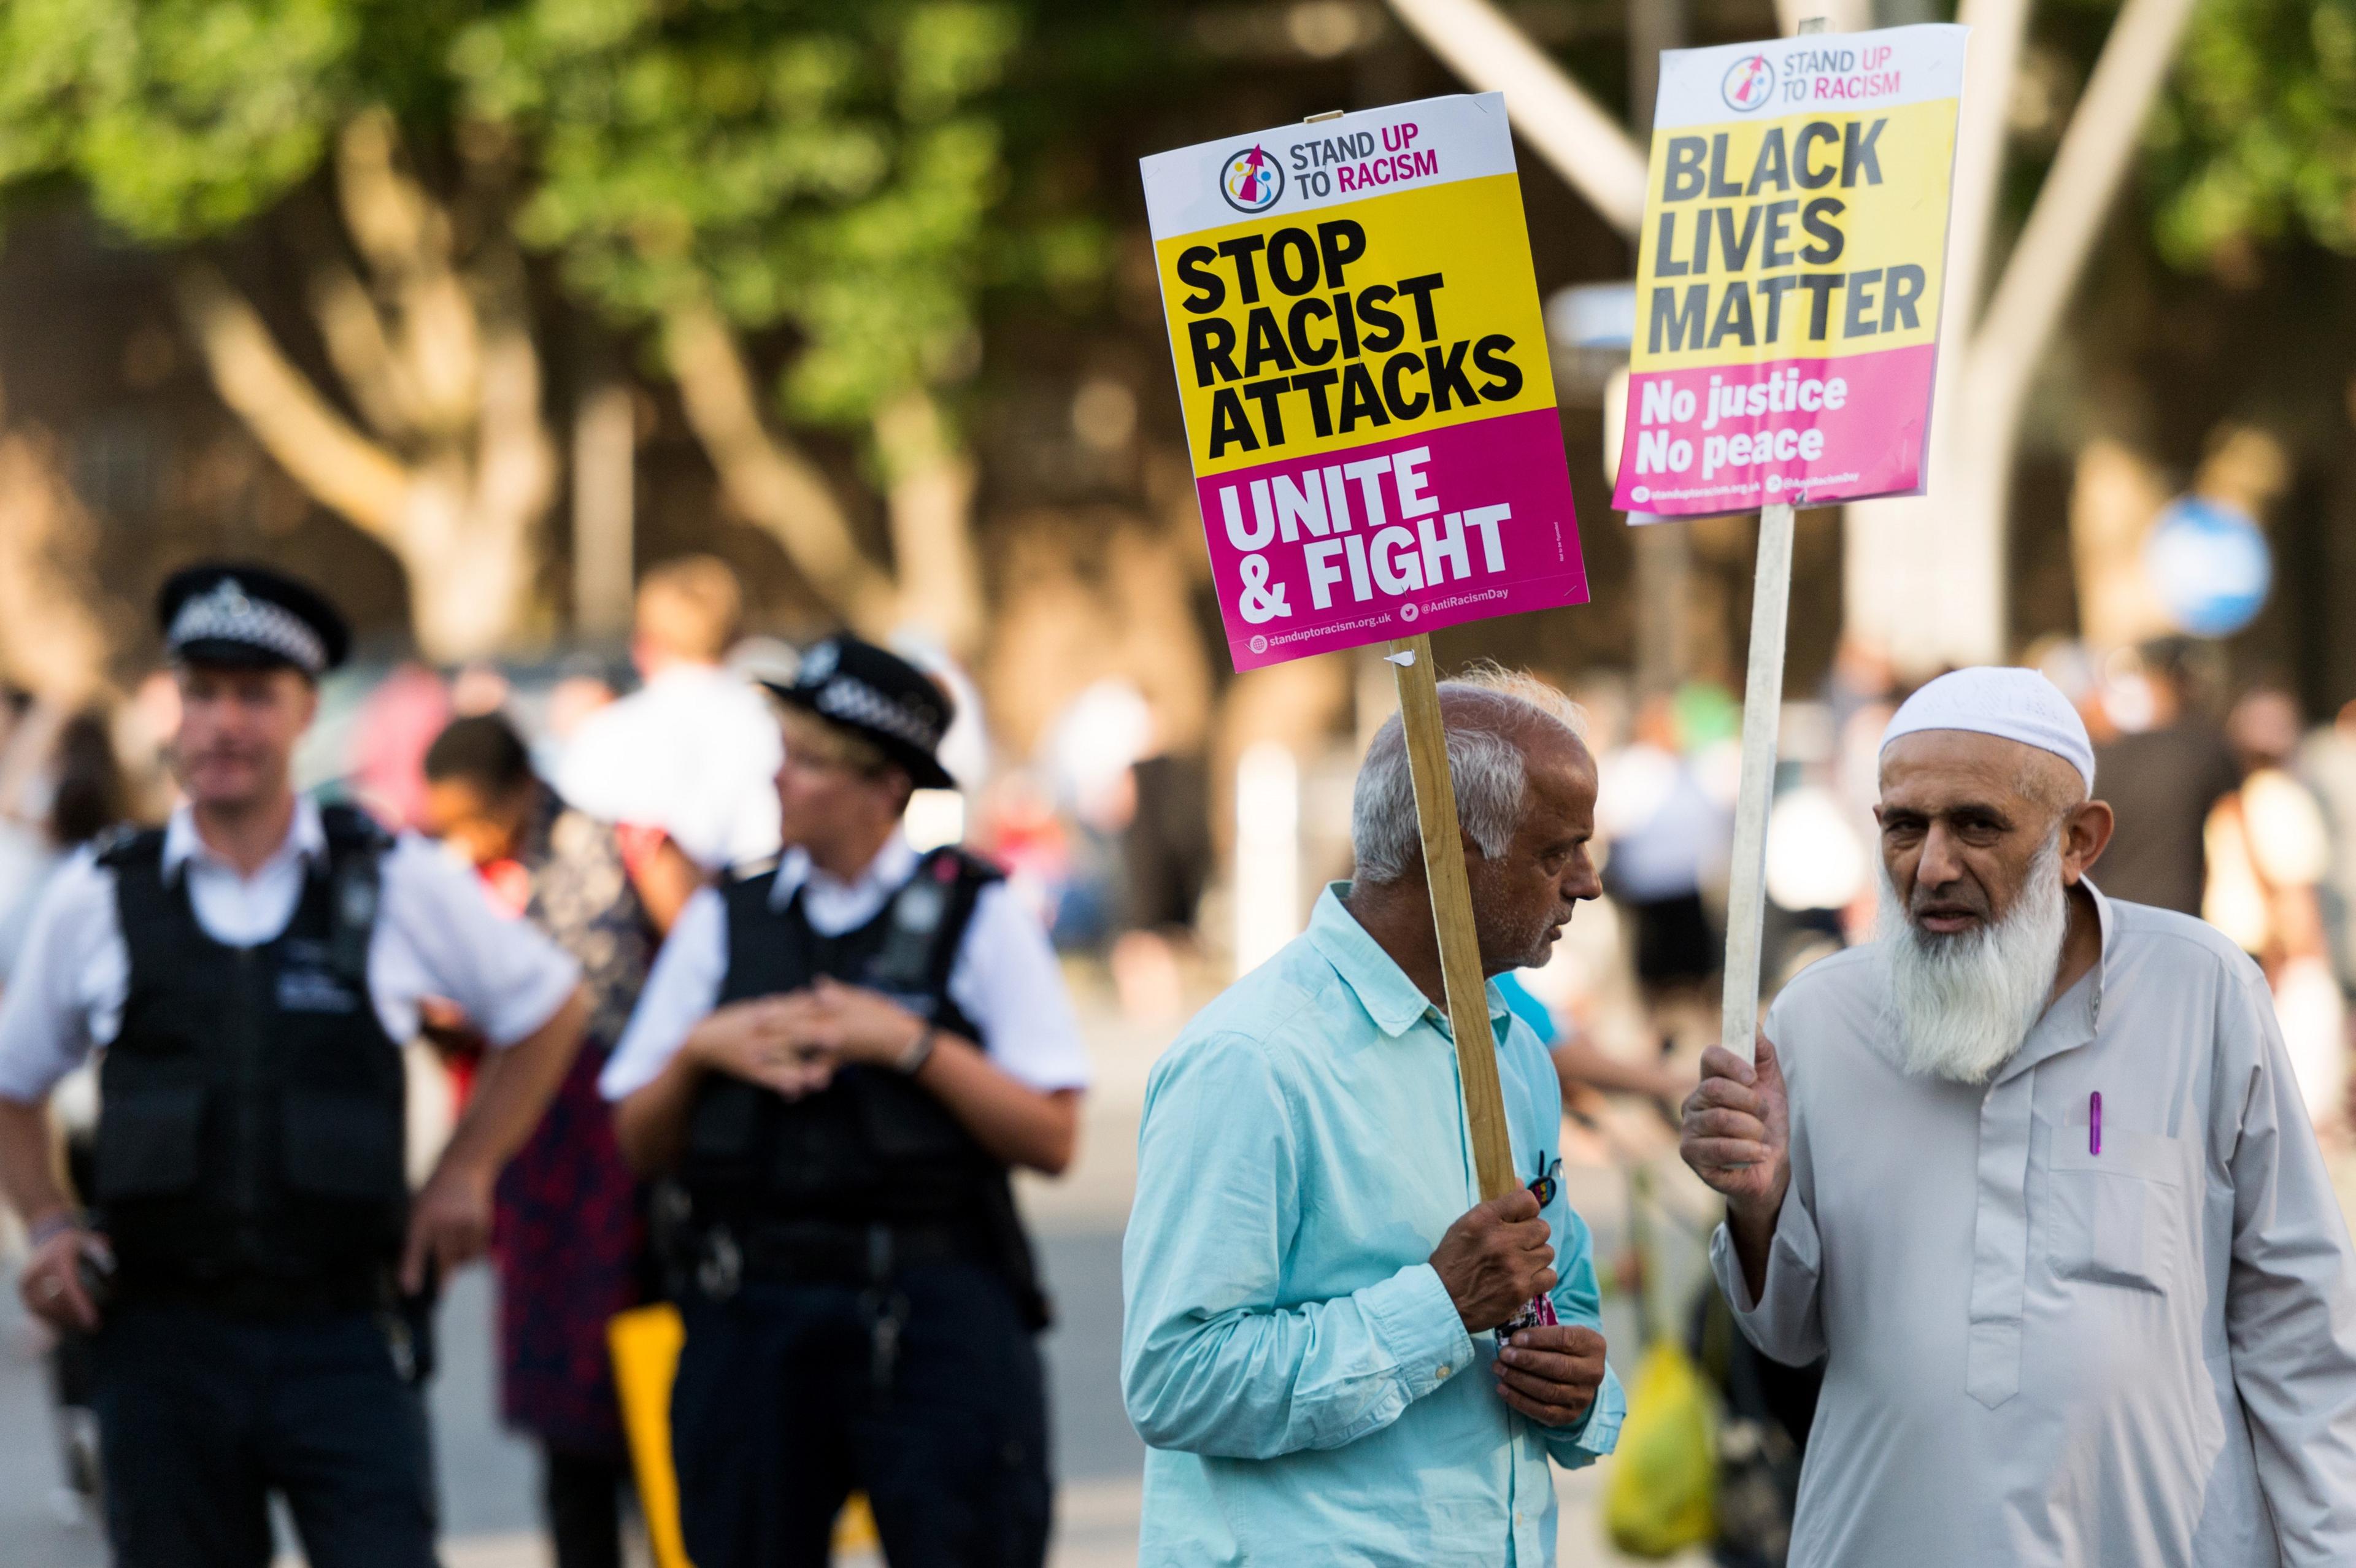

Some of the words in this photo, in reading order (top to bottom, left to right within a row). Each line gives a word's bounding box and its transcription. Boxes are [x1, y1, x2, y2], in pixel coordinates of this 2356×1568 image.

[1783, 50, 1855, 77] STAND
[1862, 46, 1892, 71] UP
[1783, 80, 1807, 103] TO
[1814, 71, 1901, 100] RACISM
[1290, 131, 1376, 171] STAND
[1382, 122, 1419, 152] UP
[1295, 171, 1331, 200] TO
[1337, 148, 1439, 193] RACISM
[1662, 118, 1888, 202] BLACK
[1177, 219, 1366, 315] STOP
[1655, 197, 1847, 277] LIVES
[1188, 272, 1444, 388] RACIST
[1648, 264, 1926, 354] MATTER
[1209, 334, 1523, 459] ATTACKS
[1640, 379, 1696, 426] No
[1702, 367, 1848, 431] justice
[1635, 429, 1693, 475] No
[1702, 428, 1825, 481] peace
[1218, 445, 1440, 551] UNITE
[1238, 553, 1292, 625] &
[1304, 502, 1512, 610] FIGHT
[1269, 612, 1392, 647] standuptoracism.org.uk
[1421, 588, 1508, 614] @AntiRacismDay
